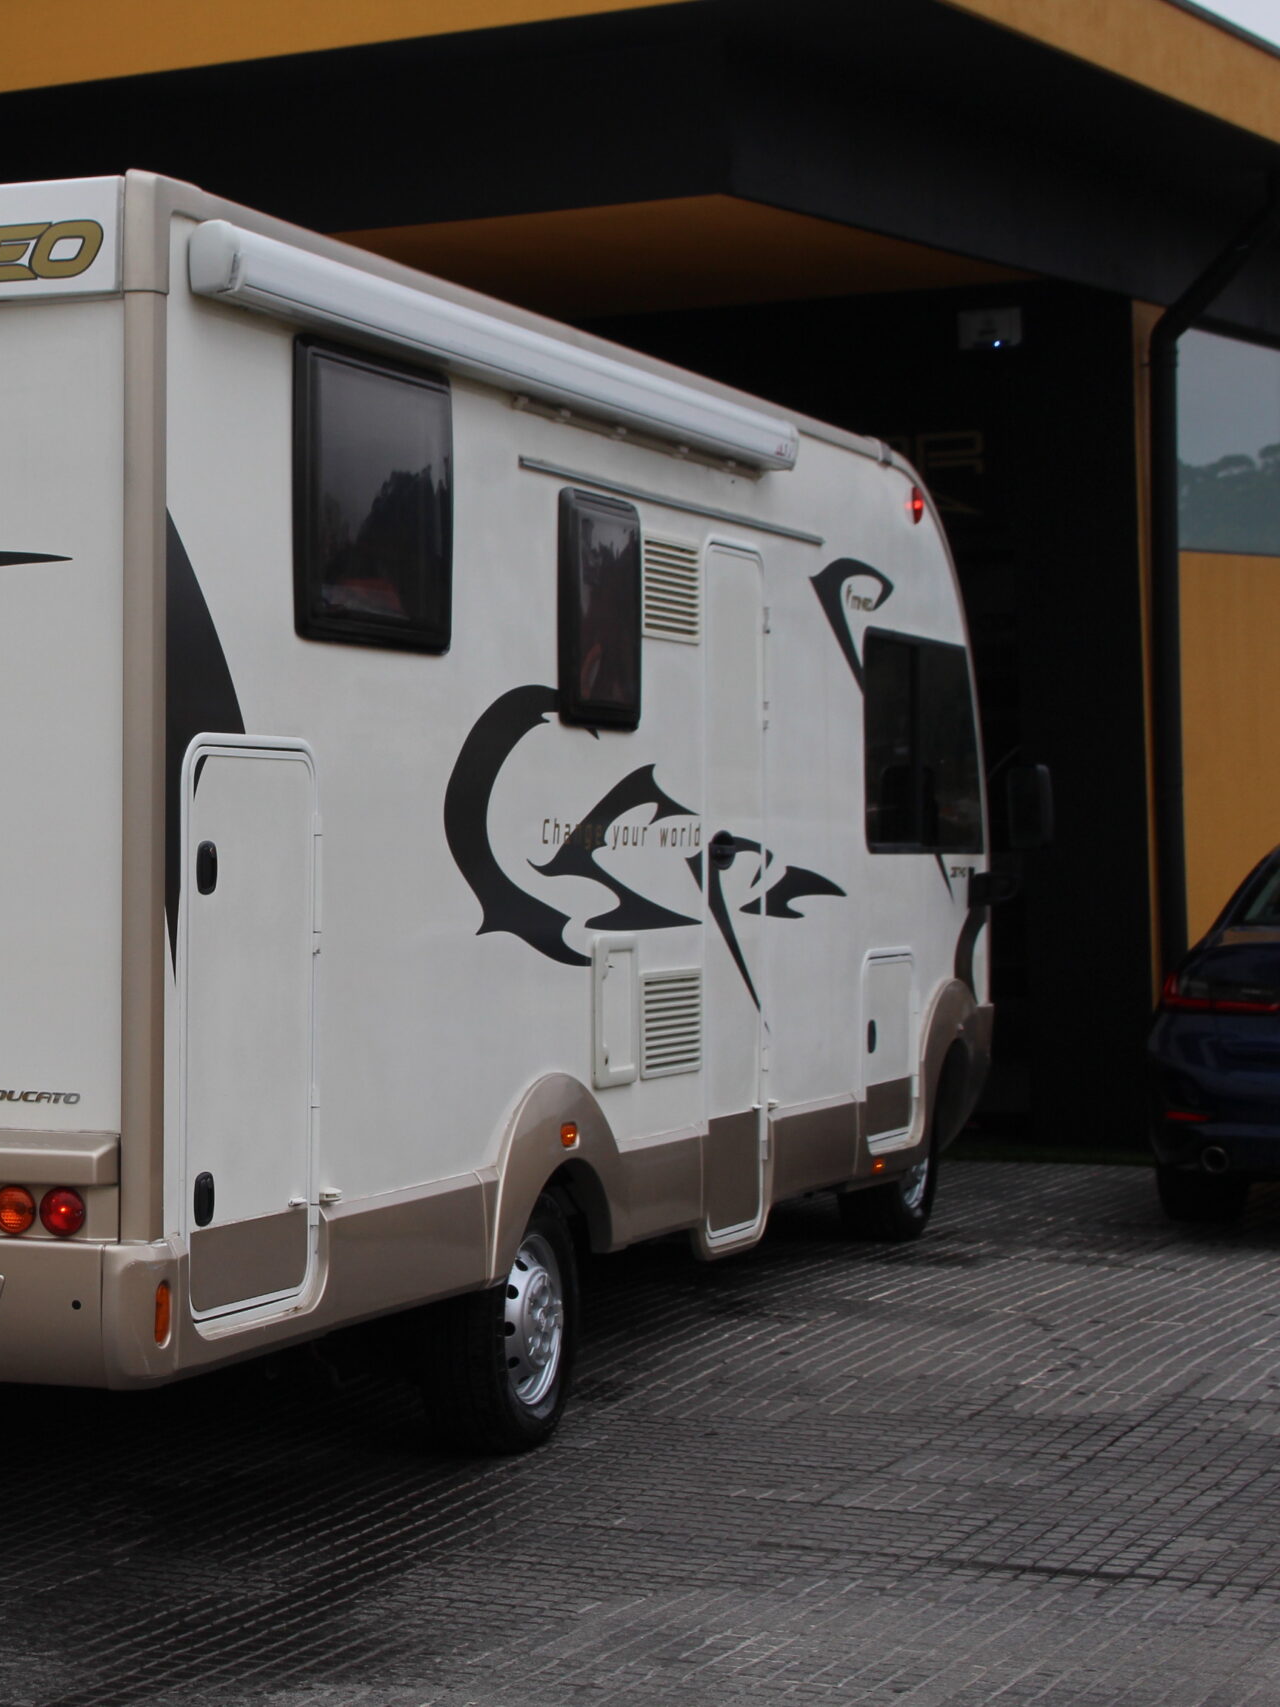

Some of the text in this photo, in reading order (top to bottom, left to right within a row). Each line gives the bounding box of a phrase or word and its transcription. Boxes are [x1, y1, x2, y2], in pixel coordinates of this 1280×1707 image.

[541, 818, 702, 850] Change your world
